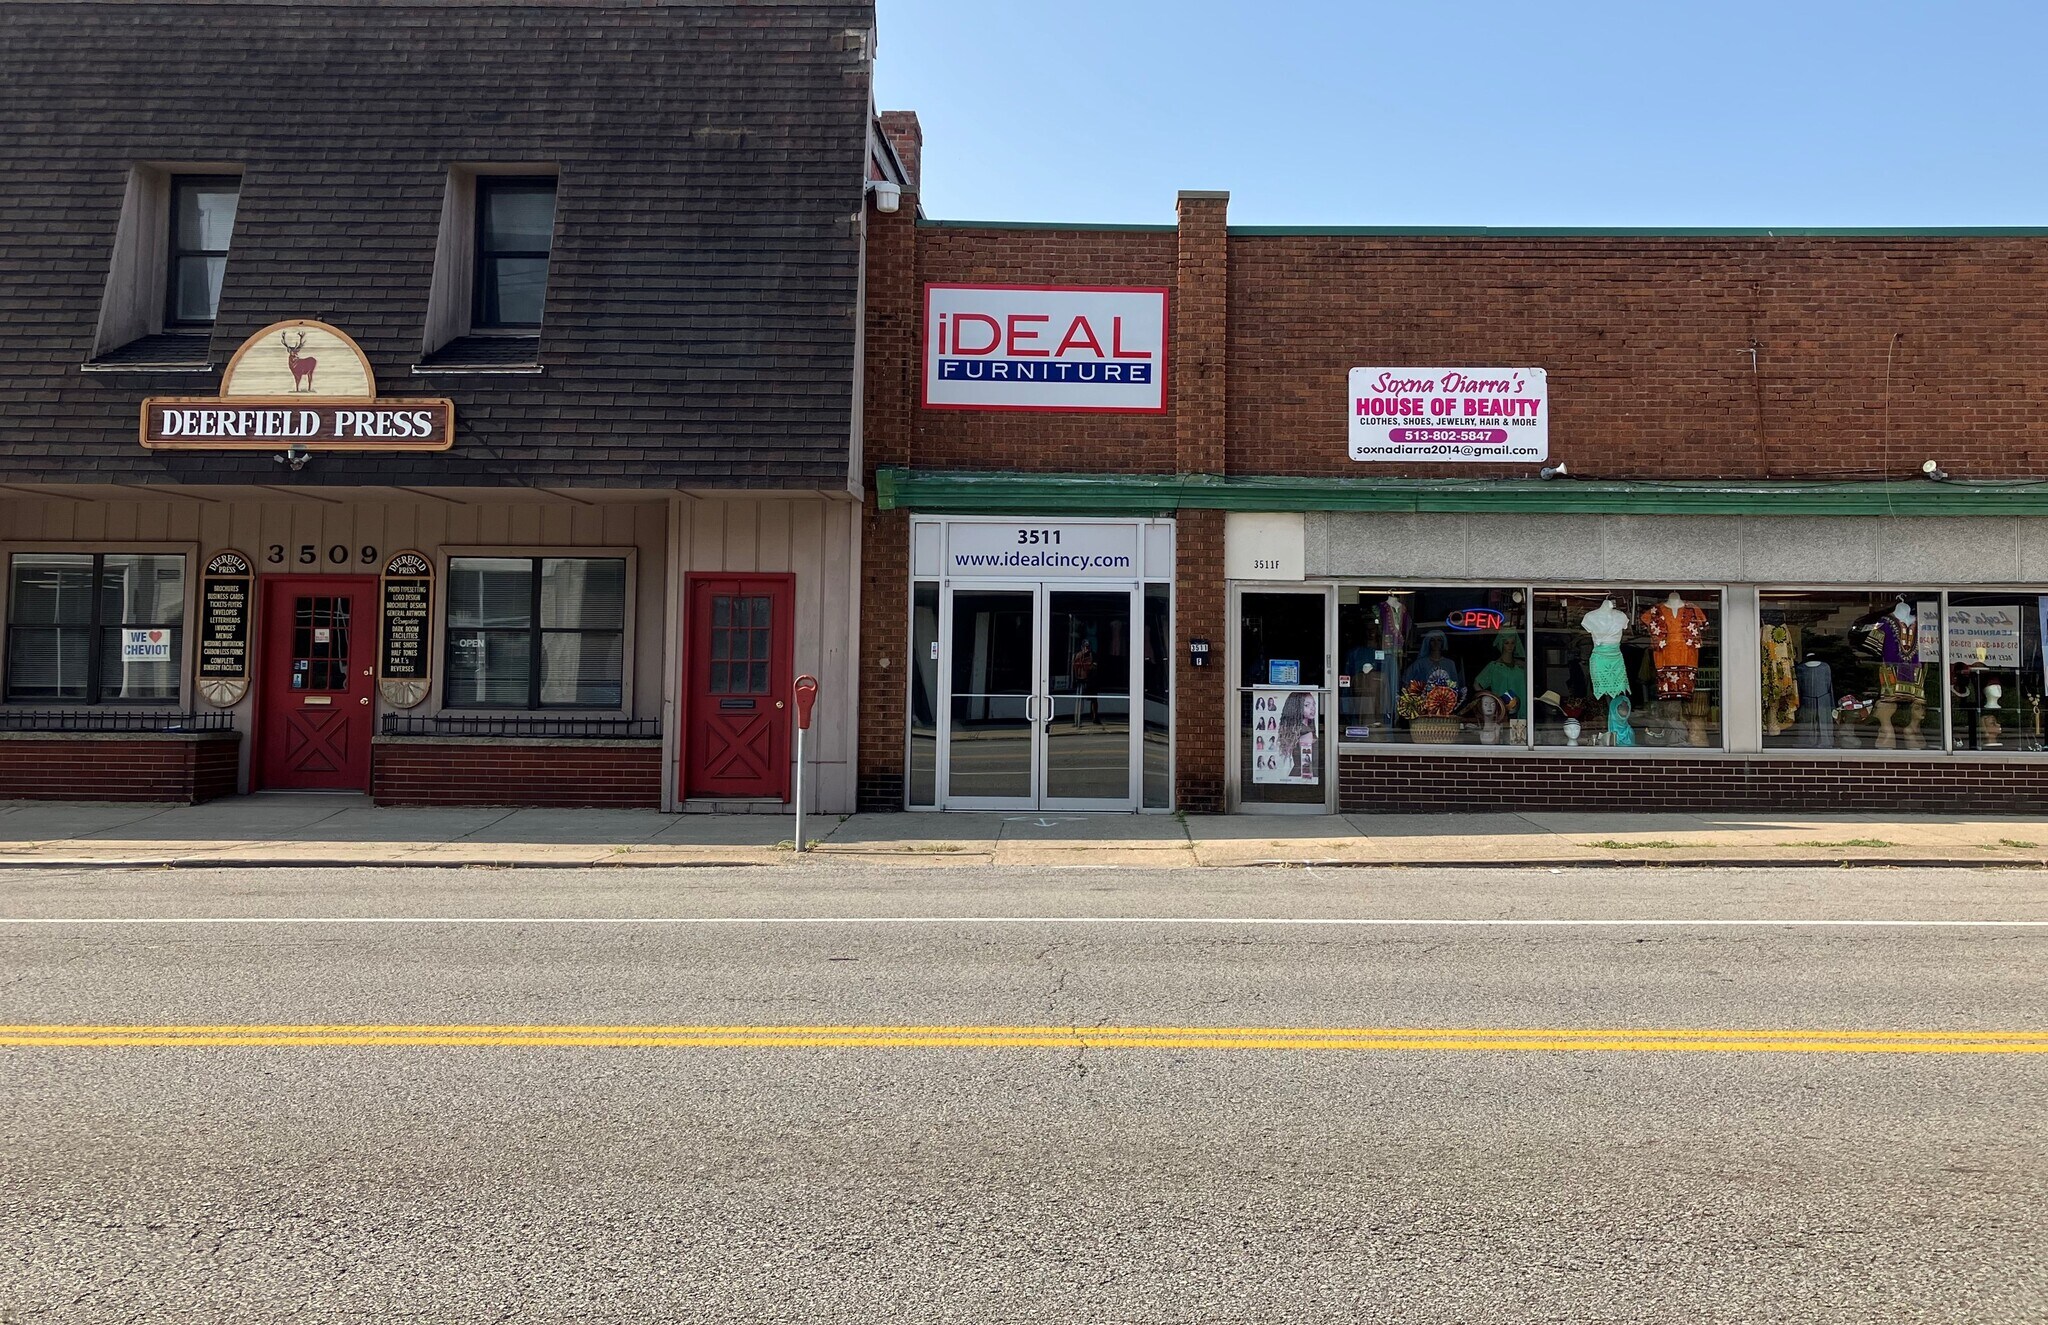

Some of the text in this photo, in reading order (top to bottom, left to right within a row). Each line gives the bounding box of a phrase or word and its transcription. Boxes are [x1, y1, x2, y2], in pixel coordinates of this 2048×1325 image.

[938, 313, 1152, 359] iDEAL
[944, 362, 1146, 381] FURNITURE
[1371, 372, 1525, 397] Soxna Diarra's
[1356, 397, 1541, 417] HOUSE OF BEAUTY
[161, 410, 433, 438] DEERFIELD PRESS
[1360, 417, 1537, 426] CLOTHES, SHOES, JEWELRY, HAIR & MORE
[1405, 431, 1492, 441] 513-802-5847
[1356, 445, 1538, 456] soxnadiarra2014@gmail.com
[1017, 529, 1062, 545] 3511
[208, 554, 247, 571] DEERFIELD
[267, 544, 378, 564] 3509
[955, 551, 1130, 571] www.idealcincy.com
[388, 555, 427, 572] DEERFIELD
[1254, 559, 1280, 569] 3511F
[1450, 610, 1500, 630] OPEN
[131, 632, 147, 642] WE
[459, 639, 485, 648] OPEN
[124, 644, 169, 655] CHEVIOT
[1191, 644, 1209, 652] 3511
